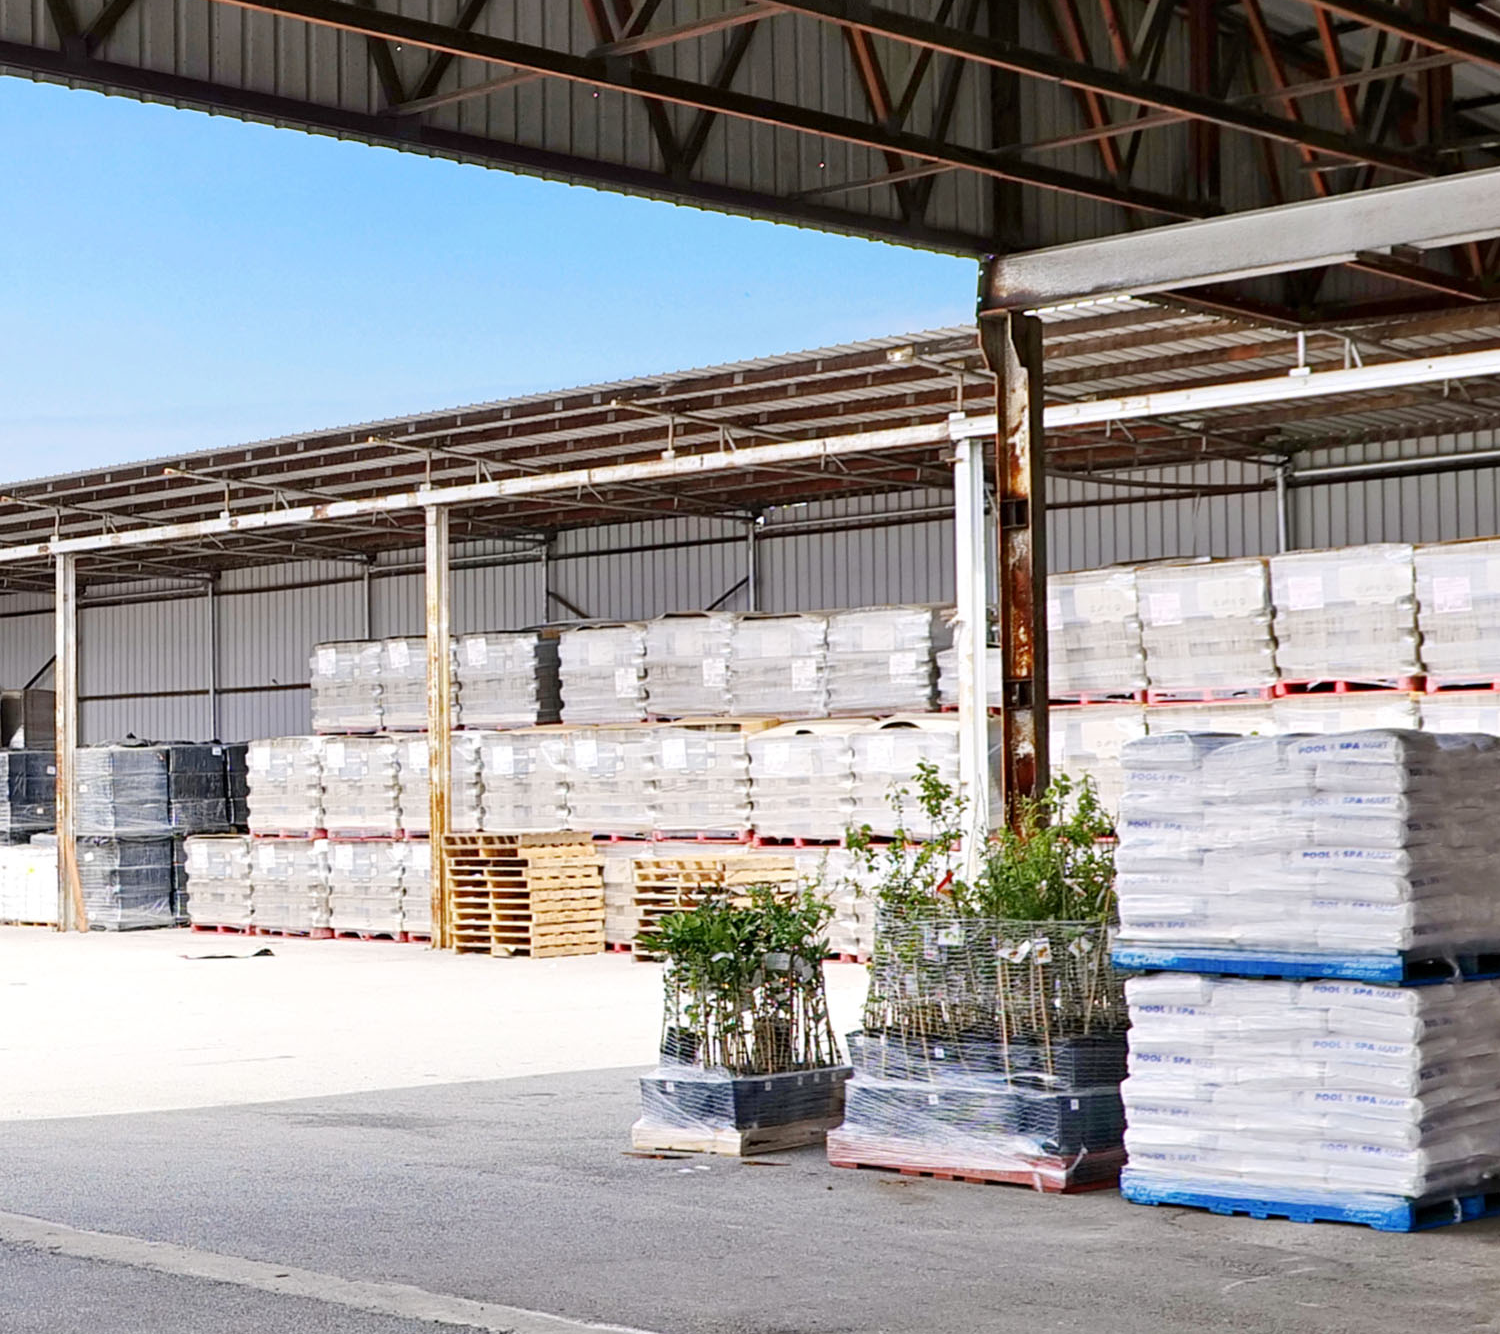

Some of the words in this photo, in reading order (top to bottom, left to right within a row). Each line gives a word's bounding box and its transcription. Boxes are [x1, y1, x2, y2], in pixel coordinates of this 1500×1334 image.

[1339, 742, 1361, 750] SPA
[1302, 851, 1331, 859] POOL
[1342, 850, 1363, 858] SPA
[1312, 986, 1341, 994] POOL
[1353, 987, 1373, 995] SPA
[1138, 1005, 1165, 1013] POOL
[1312, 1040, 1342, 1049] POOL
[1355, 1042, 1375, 1051] SPA
[1136, 1053, 1162, 1062] POOL
[1173, 1056, 1192, 1065] SPA
[1315, 1093, 1343, 1102] POOL
[1355, 1095, 1377, 1104] SPA
